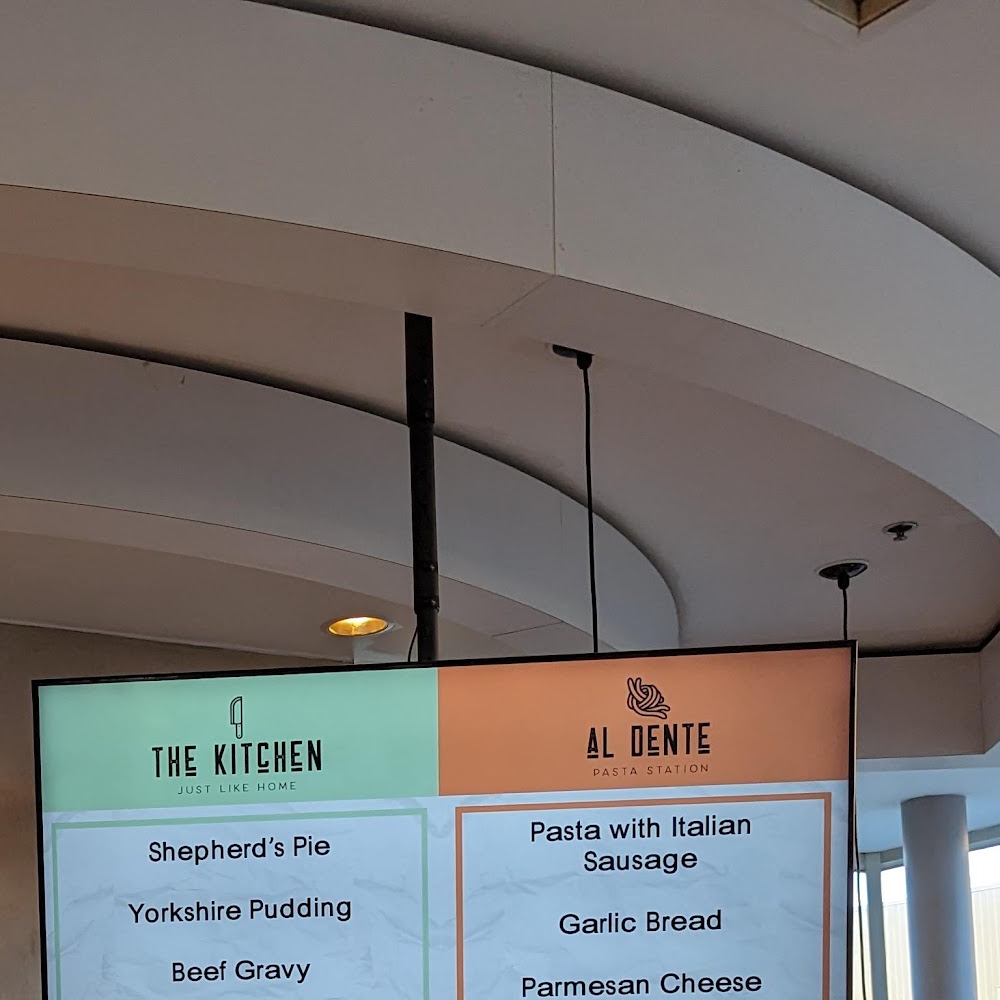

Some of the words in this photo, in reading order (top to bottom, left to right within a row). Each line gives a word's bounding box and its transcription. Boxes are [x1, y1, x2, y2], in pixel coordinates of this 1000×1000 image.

[587, 727, 614, 759] AL
[631, 722, 711, 757] DENTE
[152, 745, 198, 778] THE
[214, 739, 322, 776] KITCHEN
[593, 766, 638, 778] PASTA
[646, 764, 709, 776] STATION
[177, 785, 210, 795] JUST
[220, 783, 249, 794] LIKE
[257, 781, 297, 792] HOME
[531, 821, 601, 842] Pasta
[610, 817, 660, 840] with
[672, 815, 751, 838] Italian
[148, 836, 285, 865] Shepherd's
[293, 835, 331, 857] Pie
[584, 850, 698, 874] Sausage
[128, 900, 242, 924] Yorkshire
[250, 897, 352, 922] Pudding
[559, 912, 636, 935] Garlic
[646, 909, 722, 932] Bread
[172, 960, 226, 982] Beef
[235, 960, 310, 984] Gravy
[522, 974, 650, 998] Parmesan
[660, 972, 762, 994] Cheese
